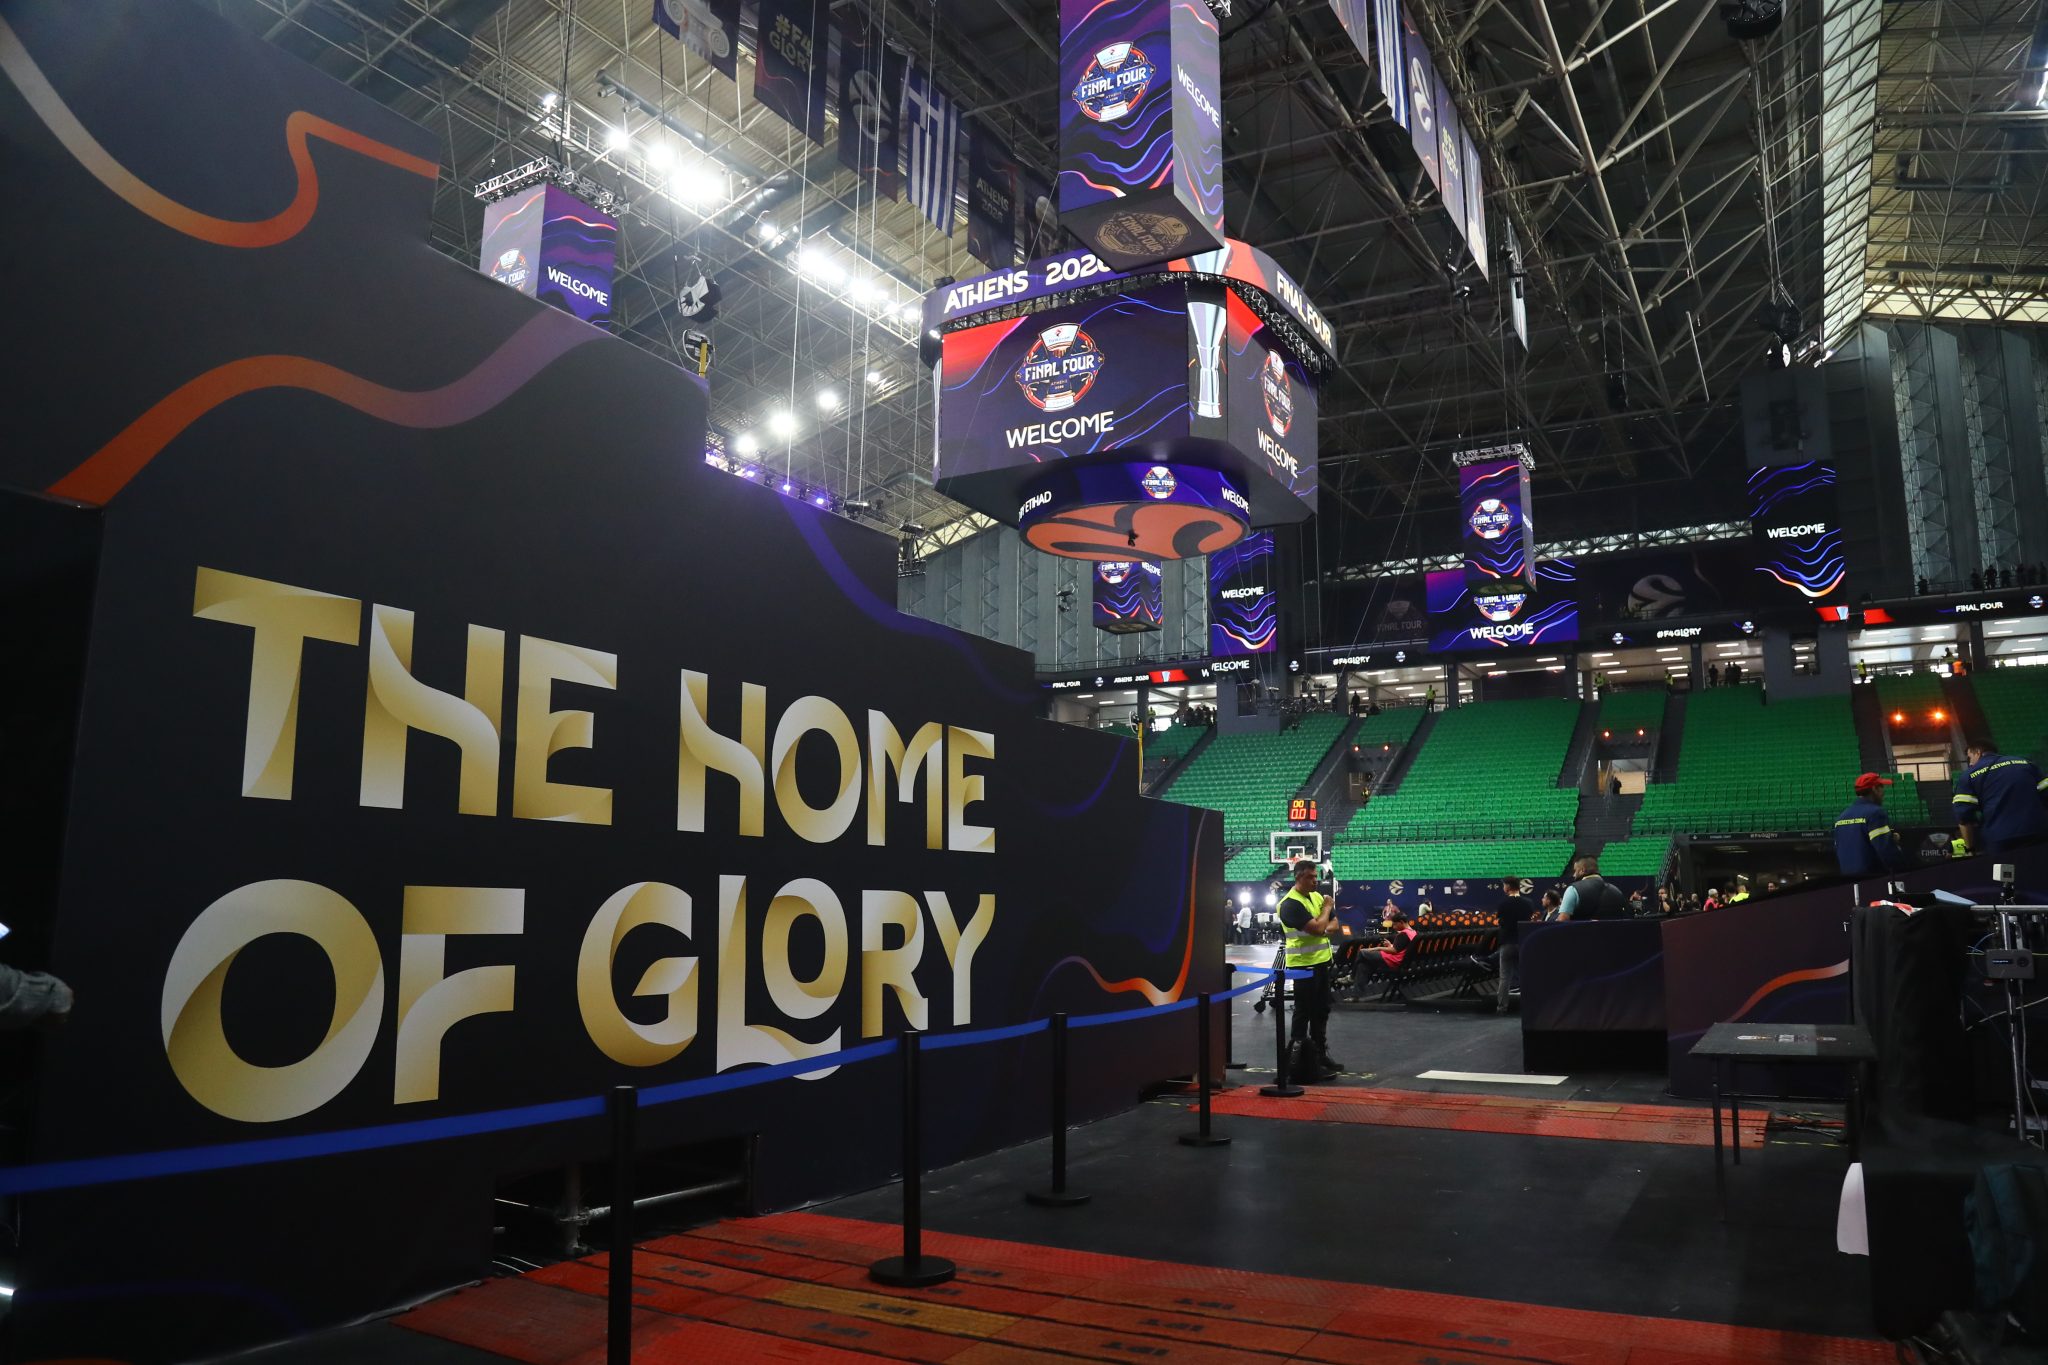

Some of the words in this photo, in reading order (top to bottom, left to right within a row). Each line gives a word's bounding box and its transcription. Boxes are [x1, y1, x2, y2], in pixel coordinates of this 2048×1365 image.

[1116, 67, 1147, 86] FOUR
[1177, 64, 1220, 129] WELCOME
[976, 177, 1009, 211] ATHENS
[547, 266, 608, 306] WELCOME
[943, 269, 1028, 314] ATHENS
[1277, 270, 1307, 322] FINAL
[1306, 303, 1333, 349] FOUR
[1062, 355, 1095, 374] FOUR
[1005, 410, 1114, 449] WELCOME
[1257, 427, 1298, 479] WELCOME
[1025, 490, 1052, 513] ETIHAD
[1766, 522, 1826, 539] WELCOME
[1221, 586, 1264, 599] WELCOME
[1955, 603, 1980, 613] FINAL
[1980, 601, 2004, 610] FOUR
[1469, 622, 1535, 640] WELCOME
[1656, 627, 1702, 639] #F4GLORY
[1332, 655, 1371, 666] #F4GLORY
[192, 565, 617, 825] THE
[677, 667, 996, 854] HOME
[161, 877, 525, 1123] OF
[576, 873, 996, 1081] GLORY
